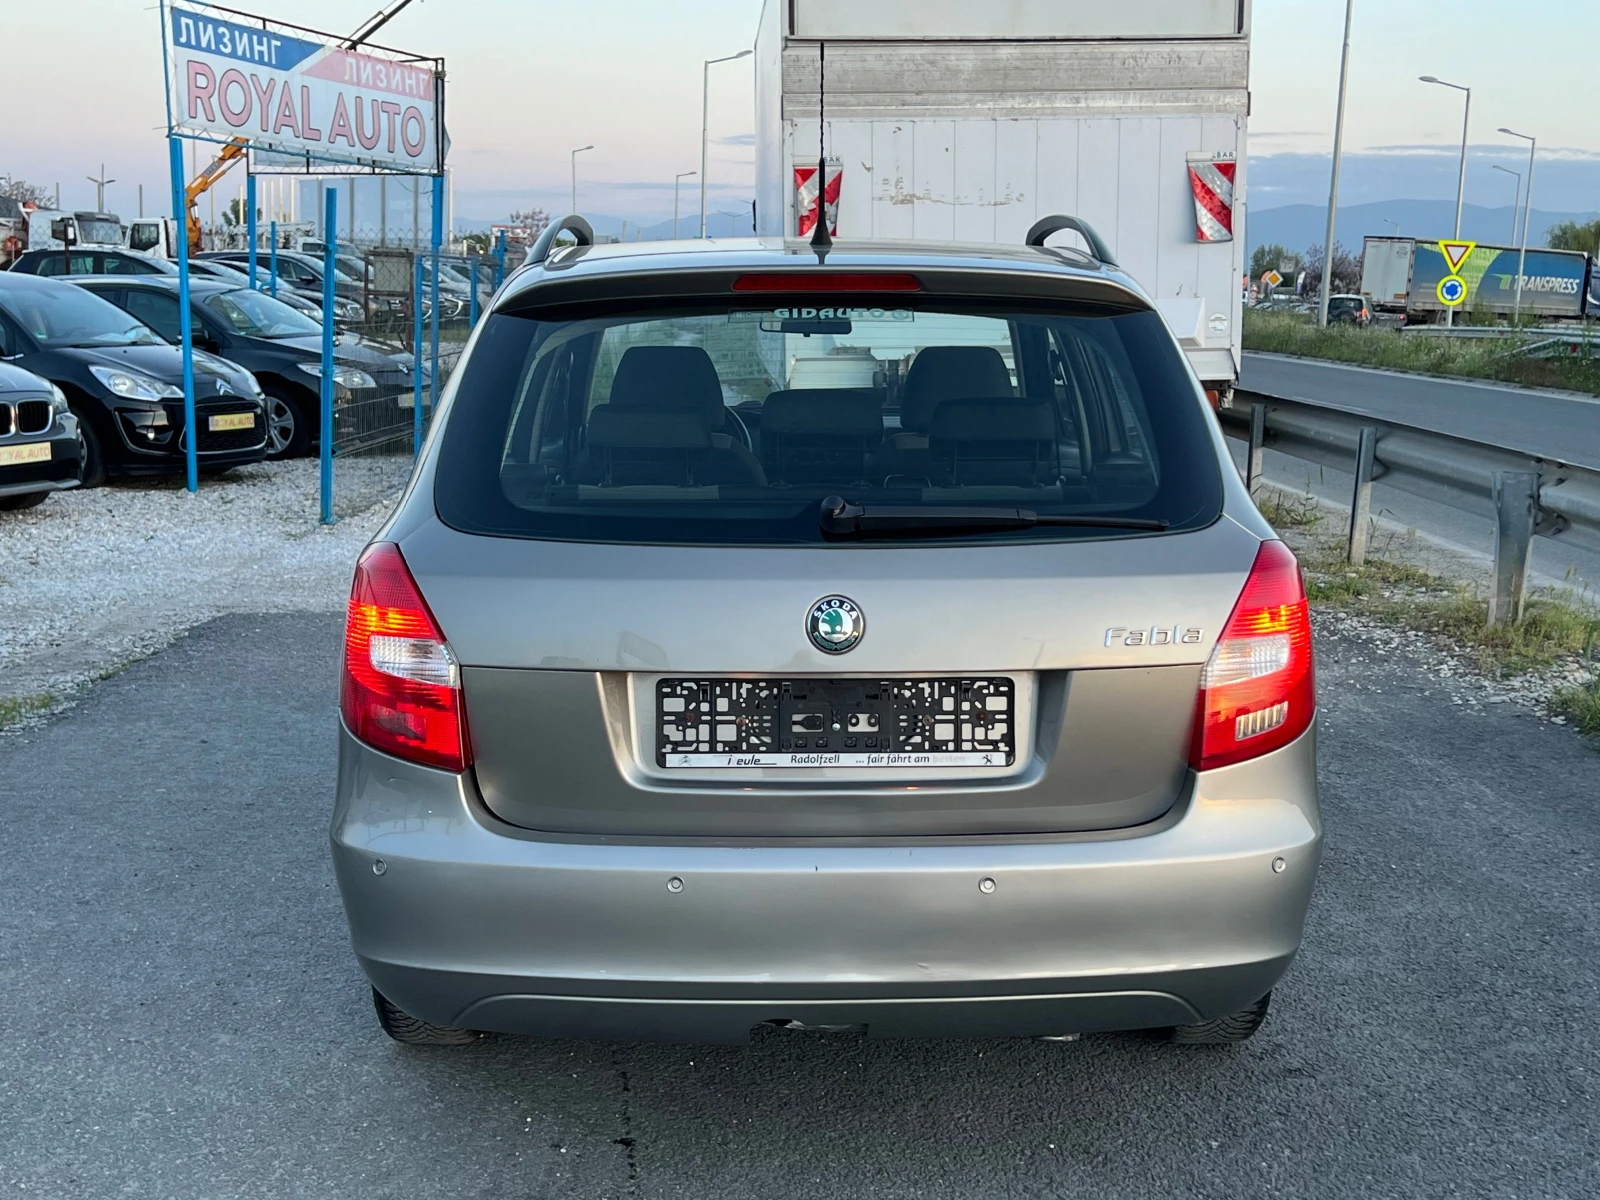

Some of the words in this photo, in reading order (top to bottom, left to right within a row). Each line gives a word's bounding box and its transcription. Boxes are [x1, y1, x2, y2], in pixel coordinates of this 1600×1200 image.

[179, 16, 282, 65] ЛИЗИНГ
[344, 57, 428, 97] ЛИЗИНГ
[187, 59, 322, 142] ROYAL
[328, 91, 426, 157] AUTO
[1513, 274, 1580, 294] TRANSPRESS
[773, 307, 885, 320] GIDAUTO
[28, 446, 50, 458] AUTO
[790, 754, 841, 765] Radolfzell
[867, 753, 885, 765] fair
[886, 753, 912, 765] fährt
